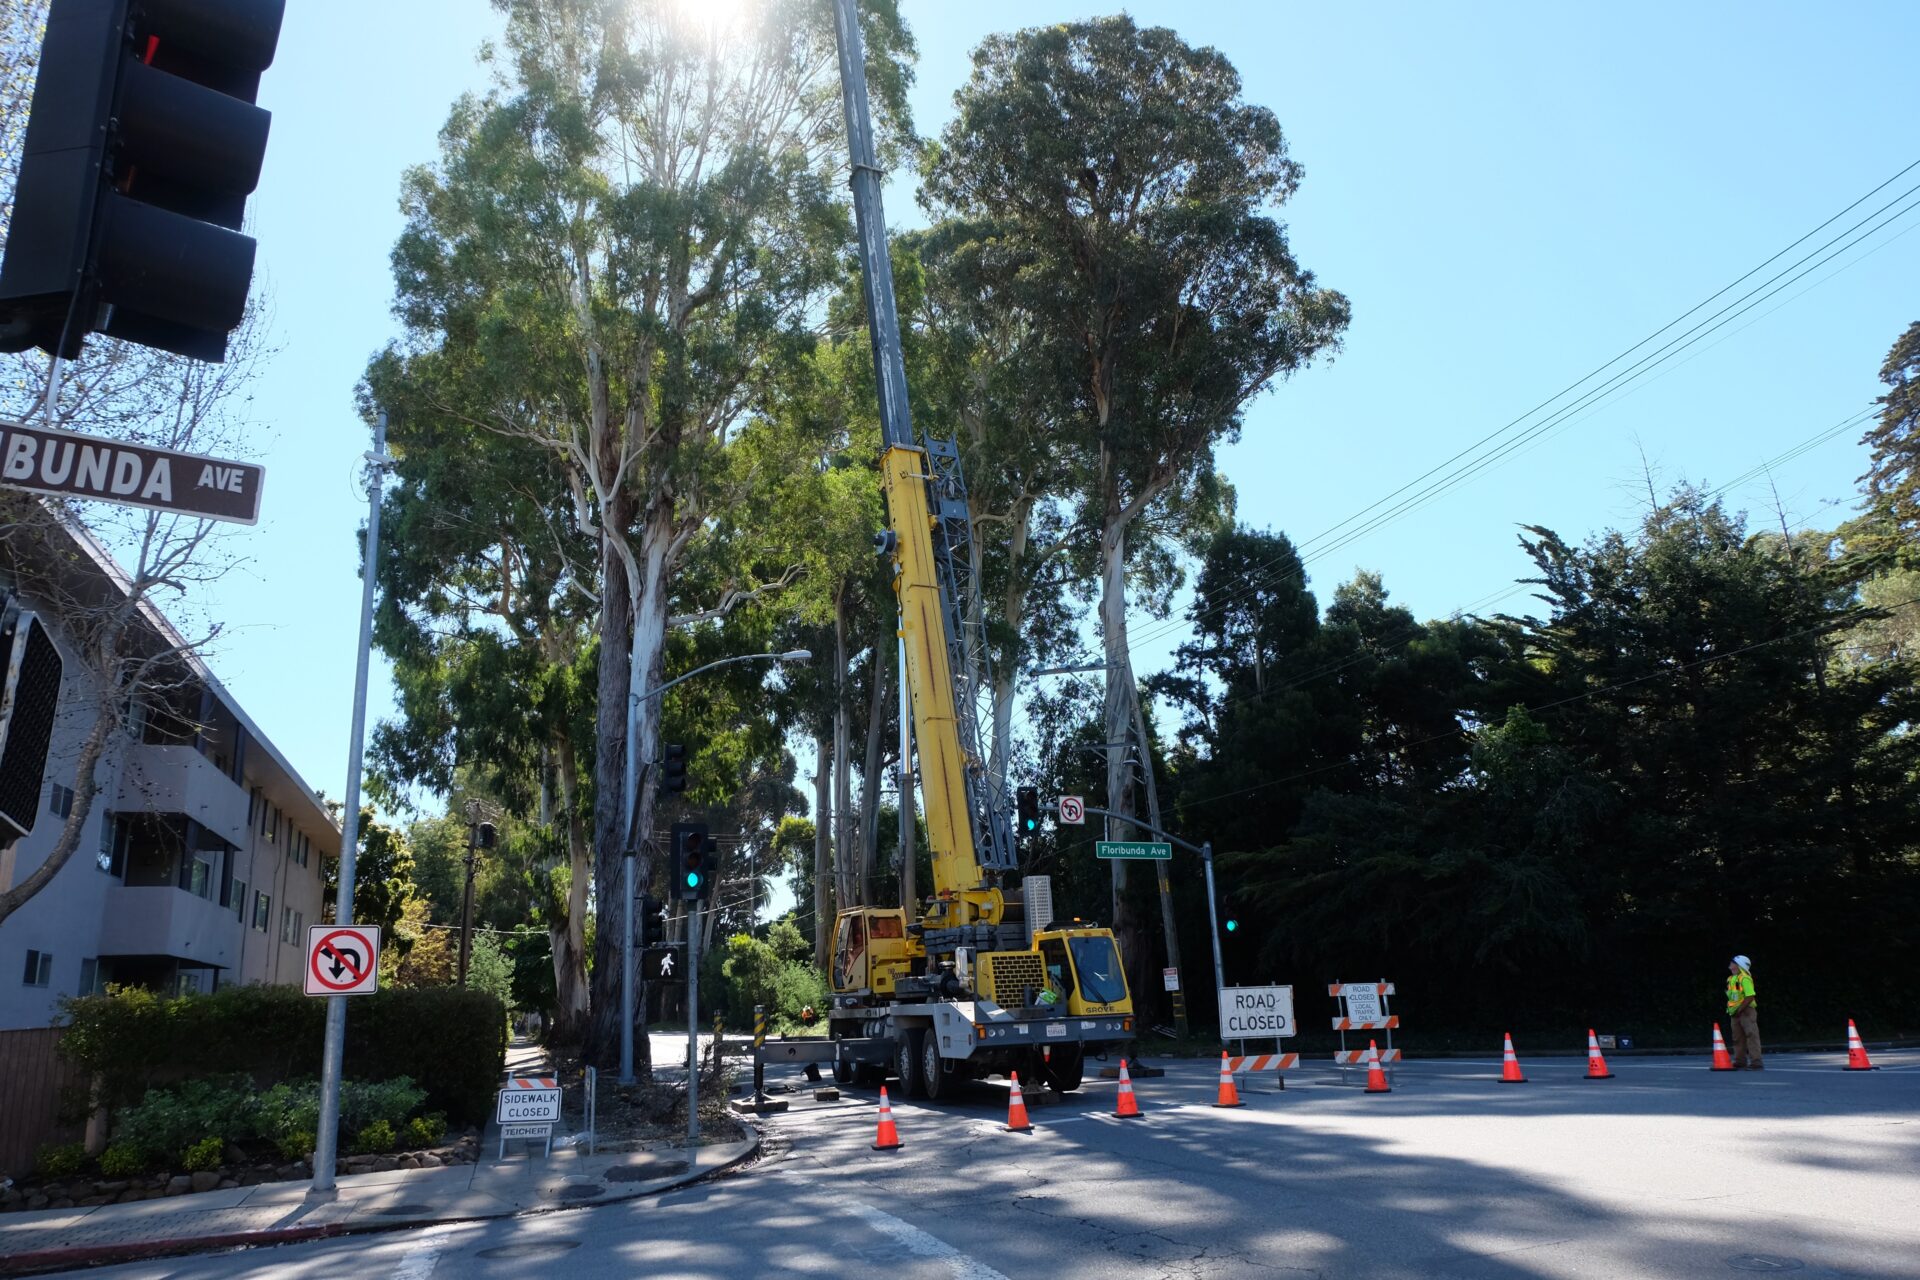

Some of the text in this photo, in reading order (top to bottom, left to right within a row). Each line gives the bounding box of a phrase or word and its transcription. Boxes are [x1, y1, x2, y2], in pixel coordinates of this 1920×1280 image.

[0, 431, 245, 502] BUNDA AVE
[1101, 845, 1167, 855] Floribunda Ave
[1352, 985, 1371, 993] ROAD
[1235, 994, 1276, 1009] ROAD
[1228, 1015, 1286, 1032] CLOSED
[504, 1093, 557, 1104] SIDEWALK
[508, 1107, 550, 1117] CLOSED
[505, 1127, 548, 1136] TEICHERT
